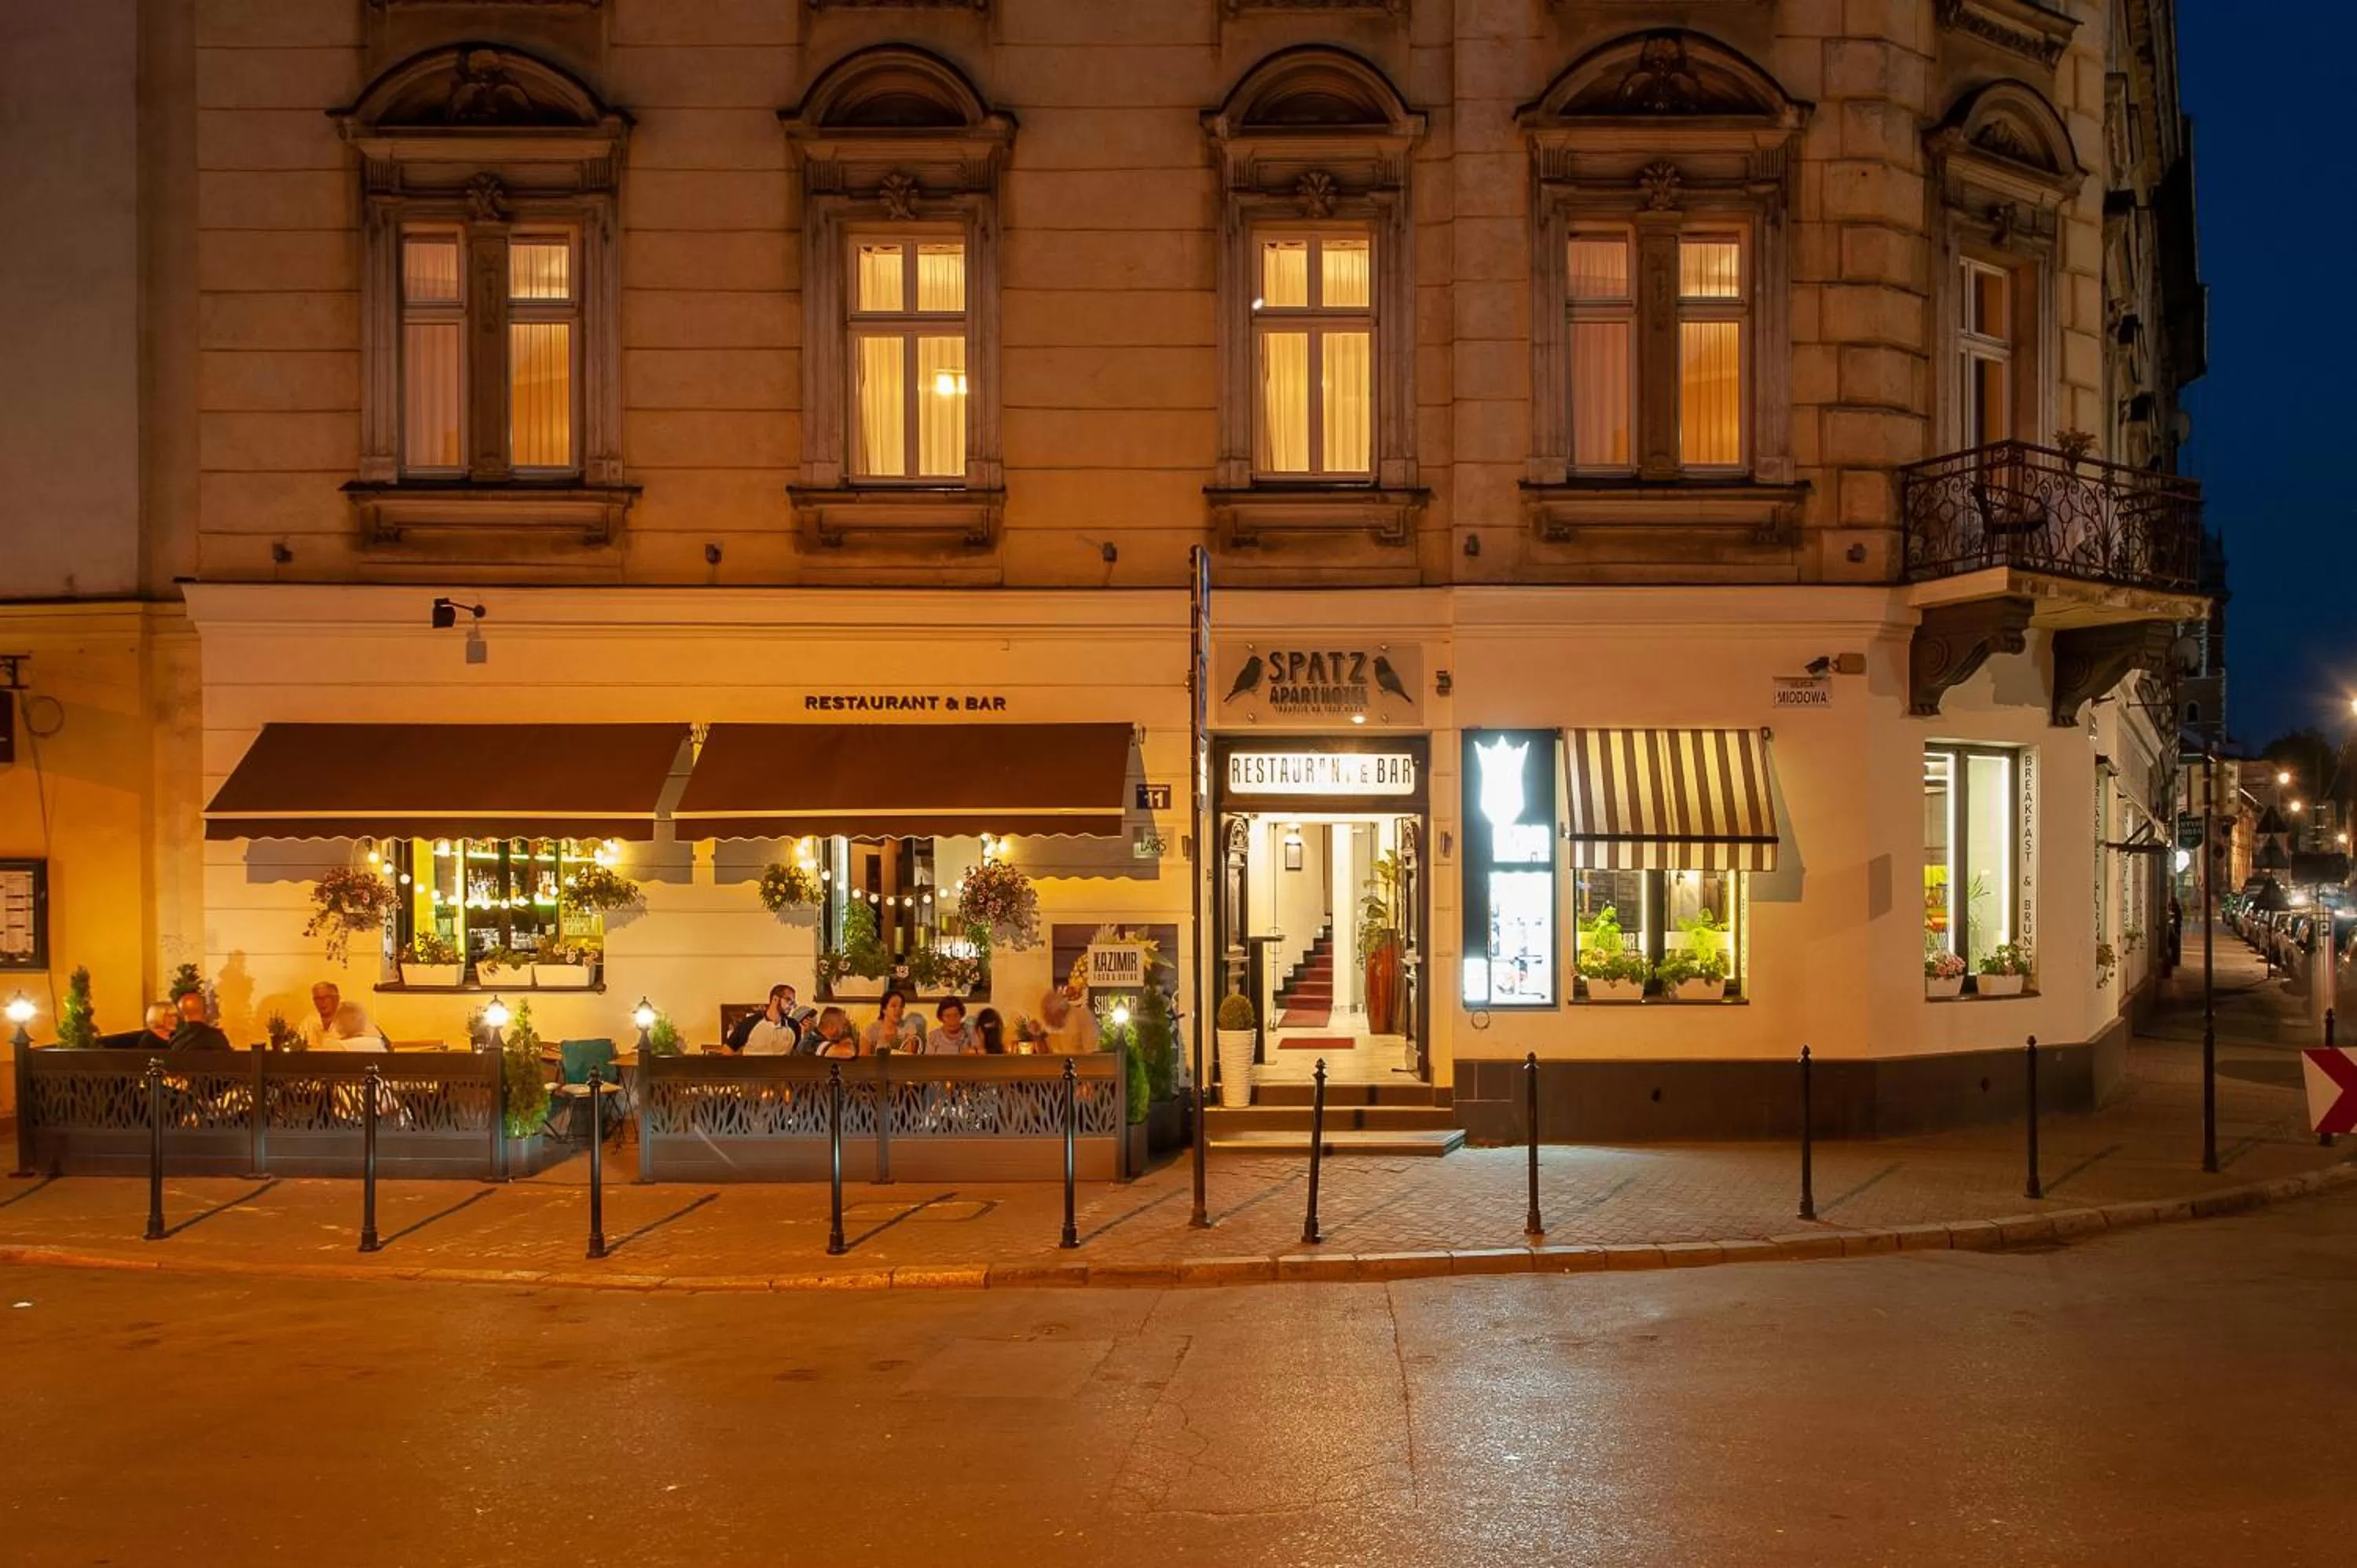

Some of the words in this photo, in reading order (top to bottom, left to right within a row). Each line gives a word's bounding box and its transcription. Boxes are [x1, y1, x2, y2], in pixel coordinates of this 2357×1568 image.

[1269, 651, 1368, 683] SPATZ
[805, 695, 940, 711] RESTAURANT
[945, 696, 959, 711] &
[965, 696, 1006, 711] BAR
[1269, 686, 1369, 704] APARTHOTEL
[1776, 691, 1827, 703] MIODOWA
[1231, 757, 1351, 784] RESTAURN
[1376, 758, 1412, 784] BAR
[1144, 791, 1164, 808] 11
[2024, 755, 2033, 862] BREAKFAST
[2023, 876, 2032, 887] &
[1093, 951, 1138, 972] KAZIMIR
